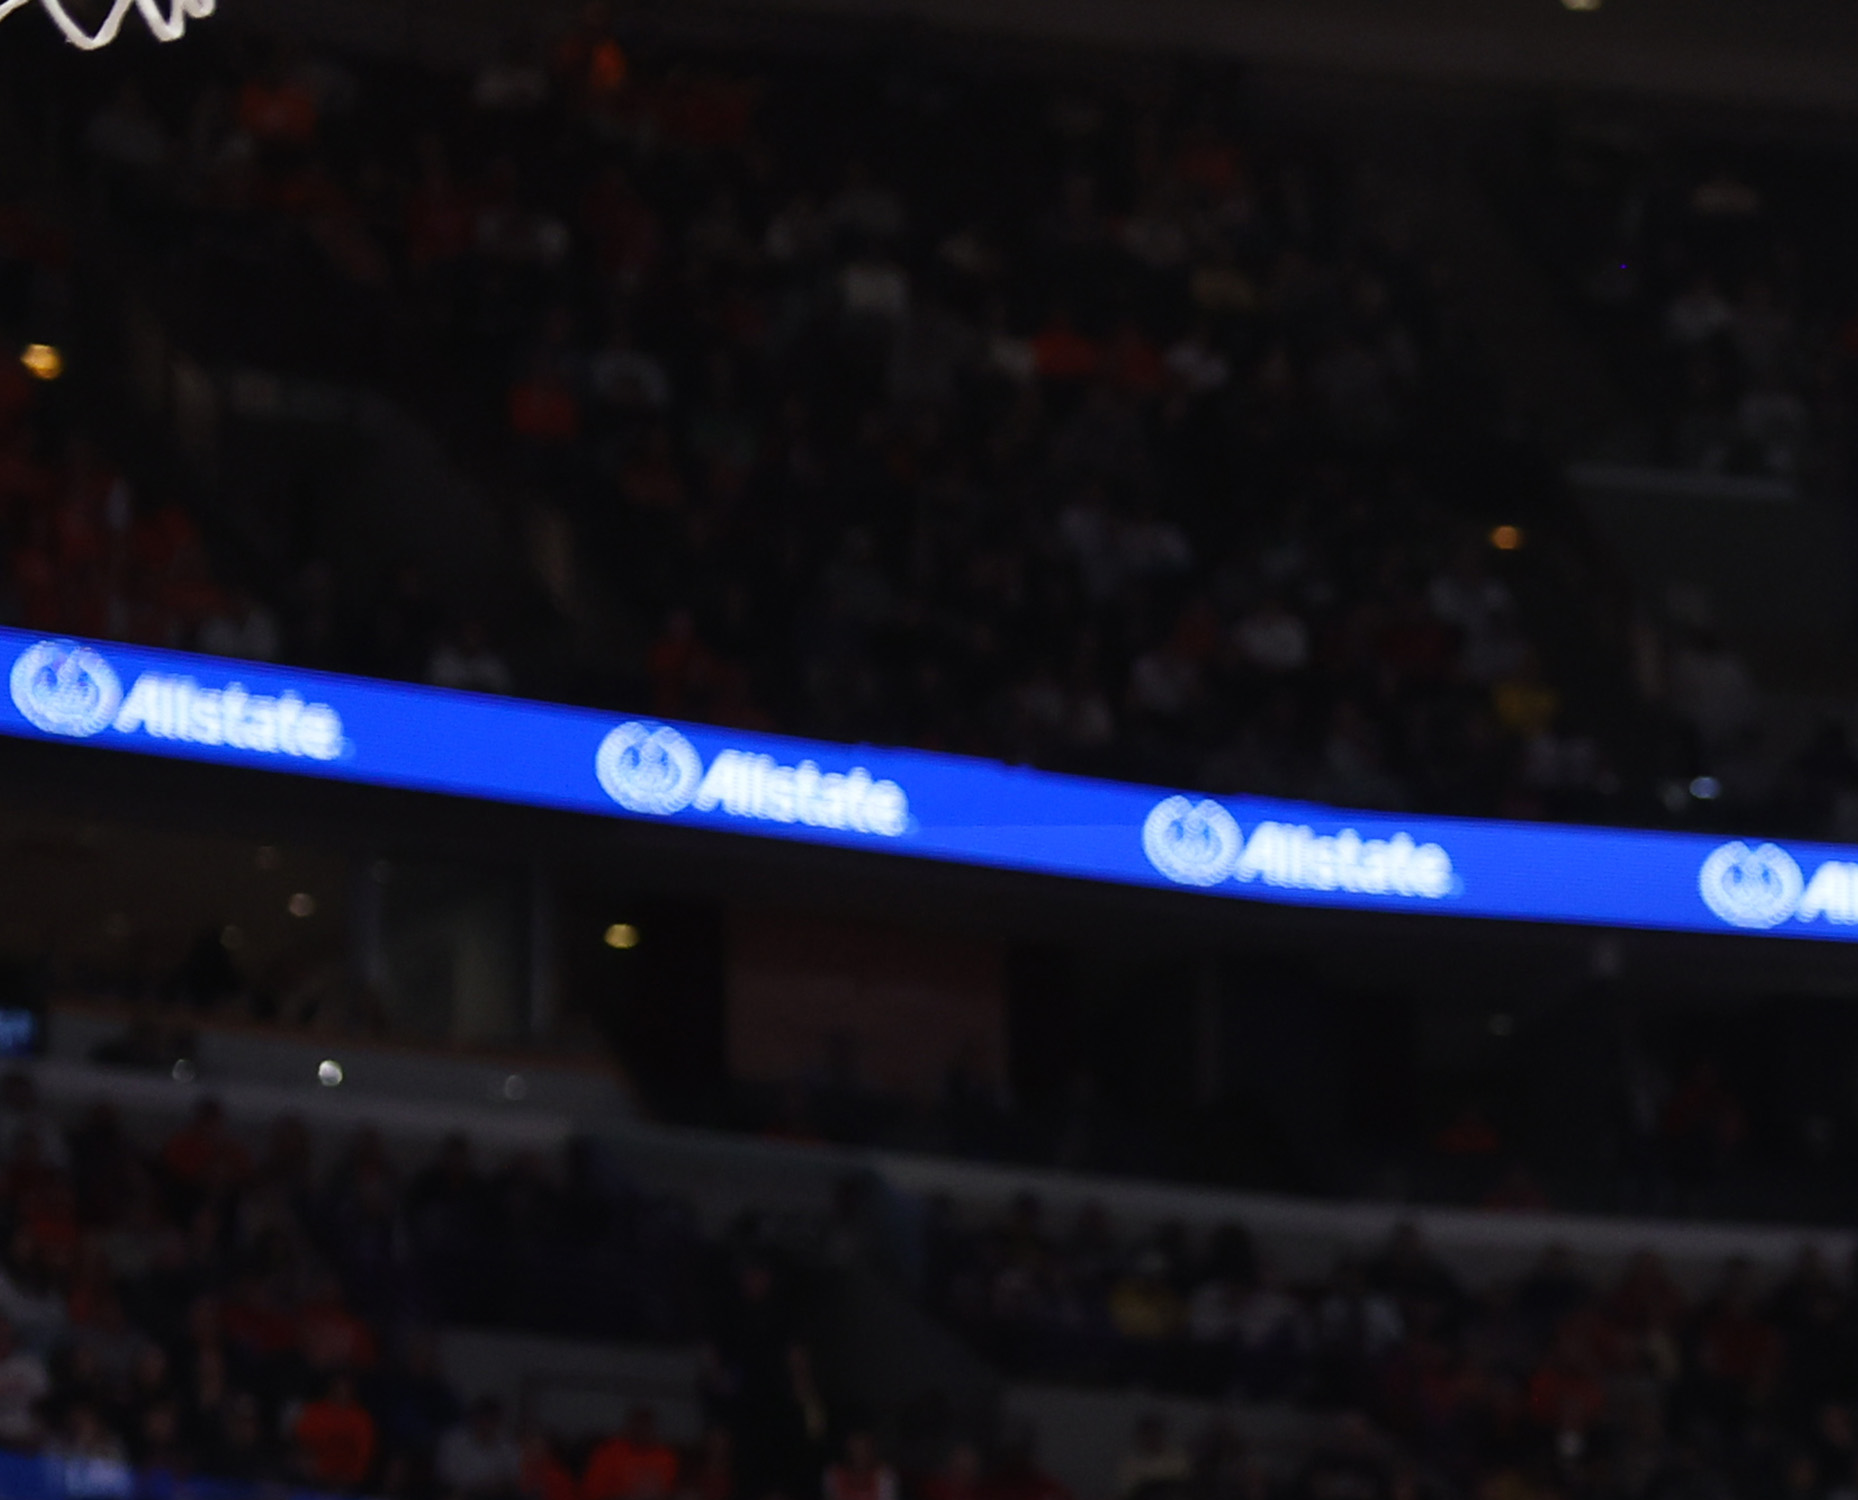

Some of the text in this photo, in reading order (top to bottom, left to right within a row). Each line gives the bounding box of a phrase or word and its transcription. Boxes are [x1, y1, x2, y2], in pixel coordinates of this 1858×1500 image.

[114, 672, 344, 762] Allstate
[692, 748, 909, 838] Allstate
[1234, 821, 1453, 899] Allstate
